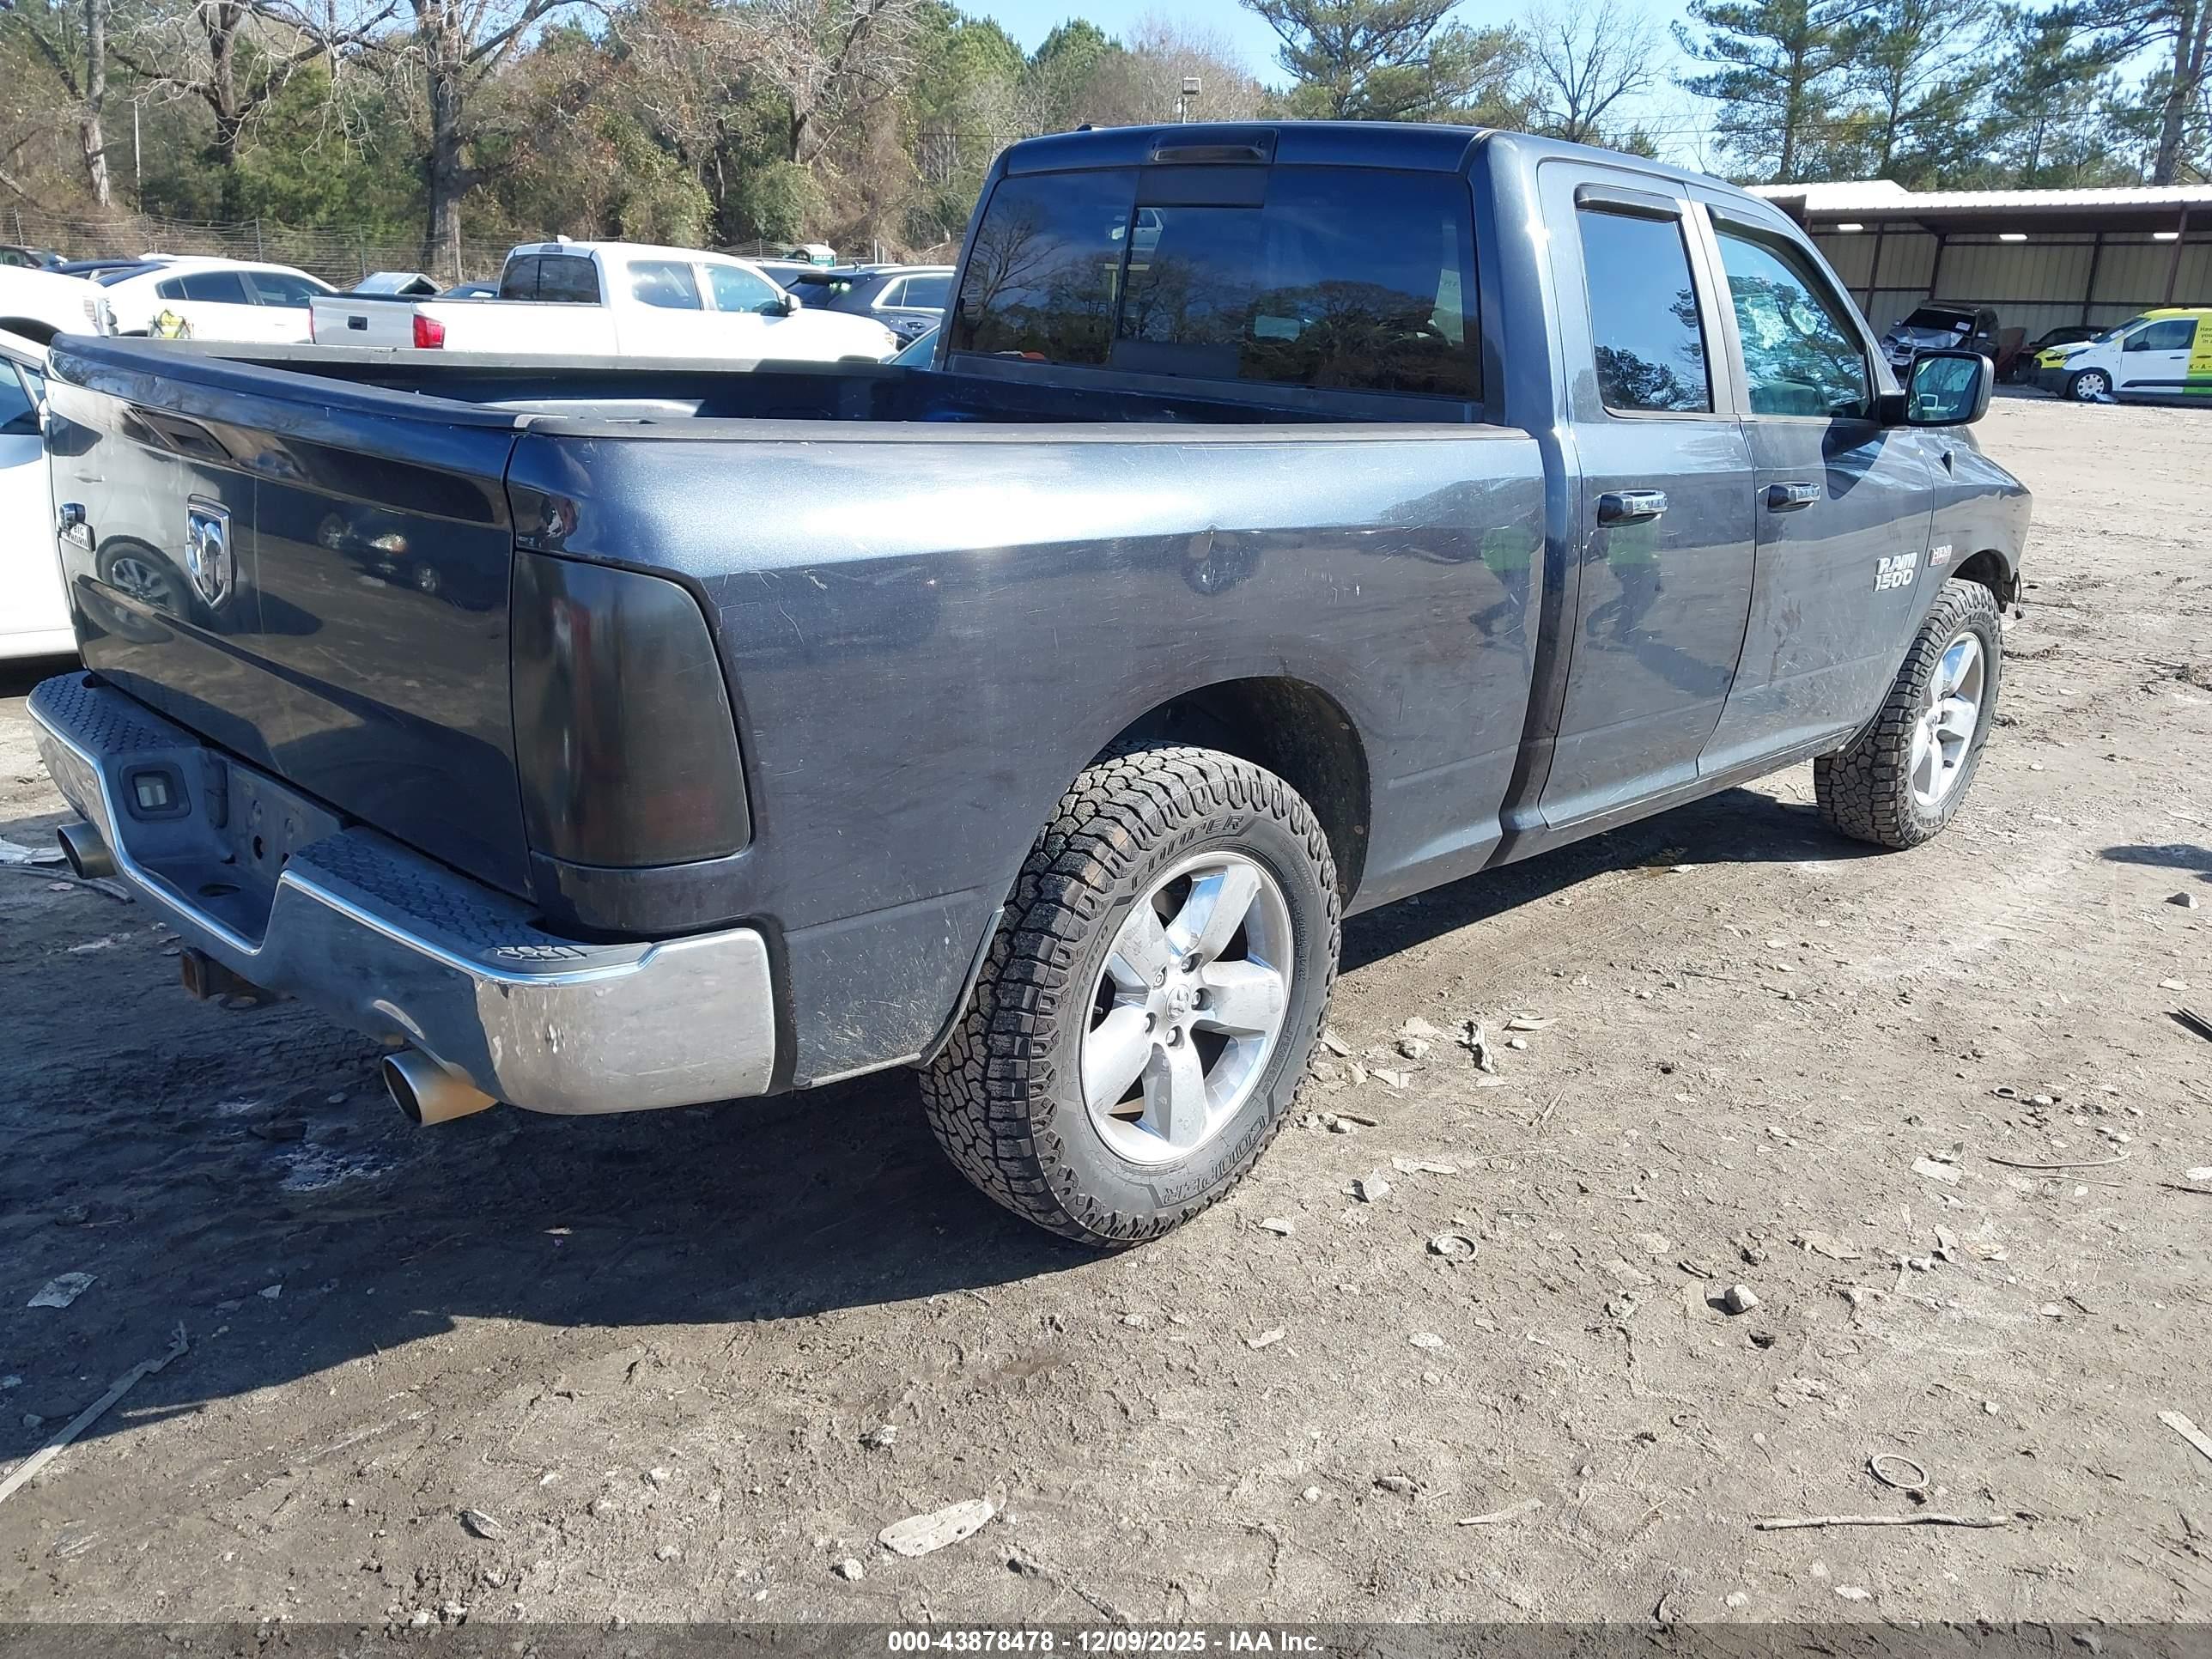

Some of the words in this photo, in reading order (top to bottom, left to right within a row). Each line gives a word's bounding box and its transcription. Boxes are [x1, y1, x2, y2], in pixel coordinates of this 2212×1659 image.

[70, 533, 88, 547] HORN
[1932, 544, 1953, 559] HEMI
[1876, 552, 1917, 574] RAM
[1873, 568, 1914, 592] 1500
